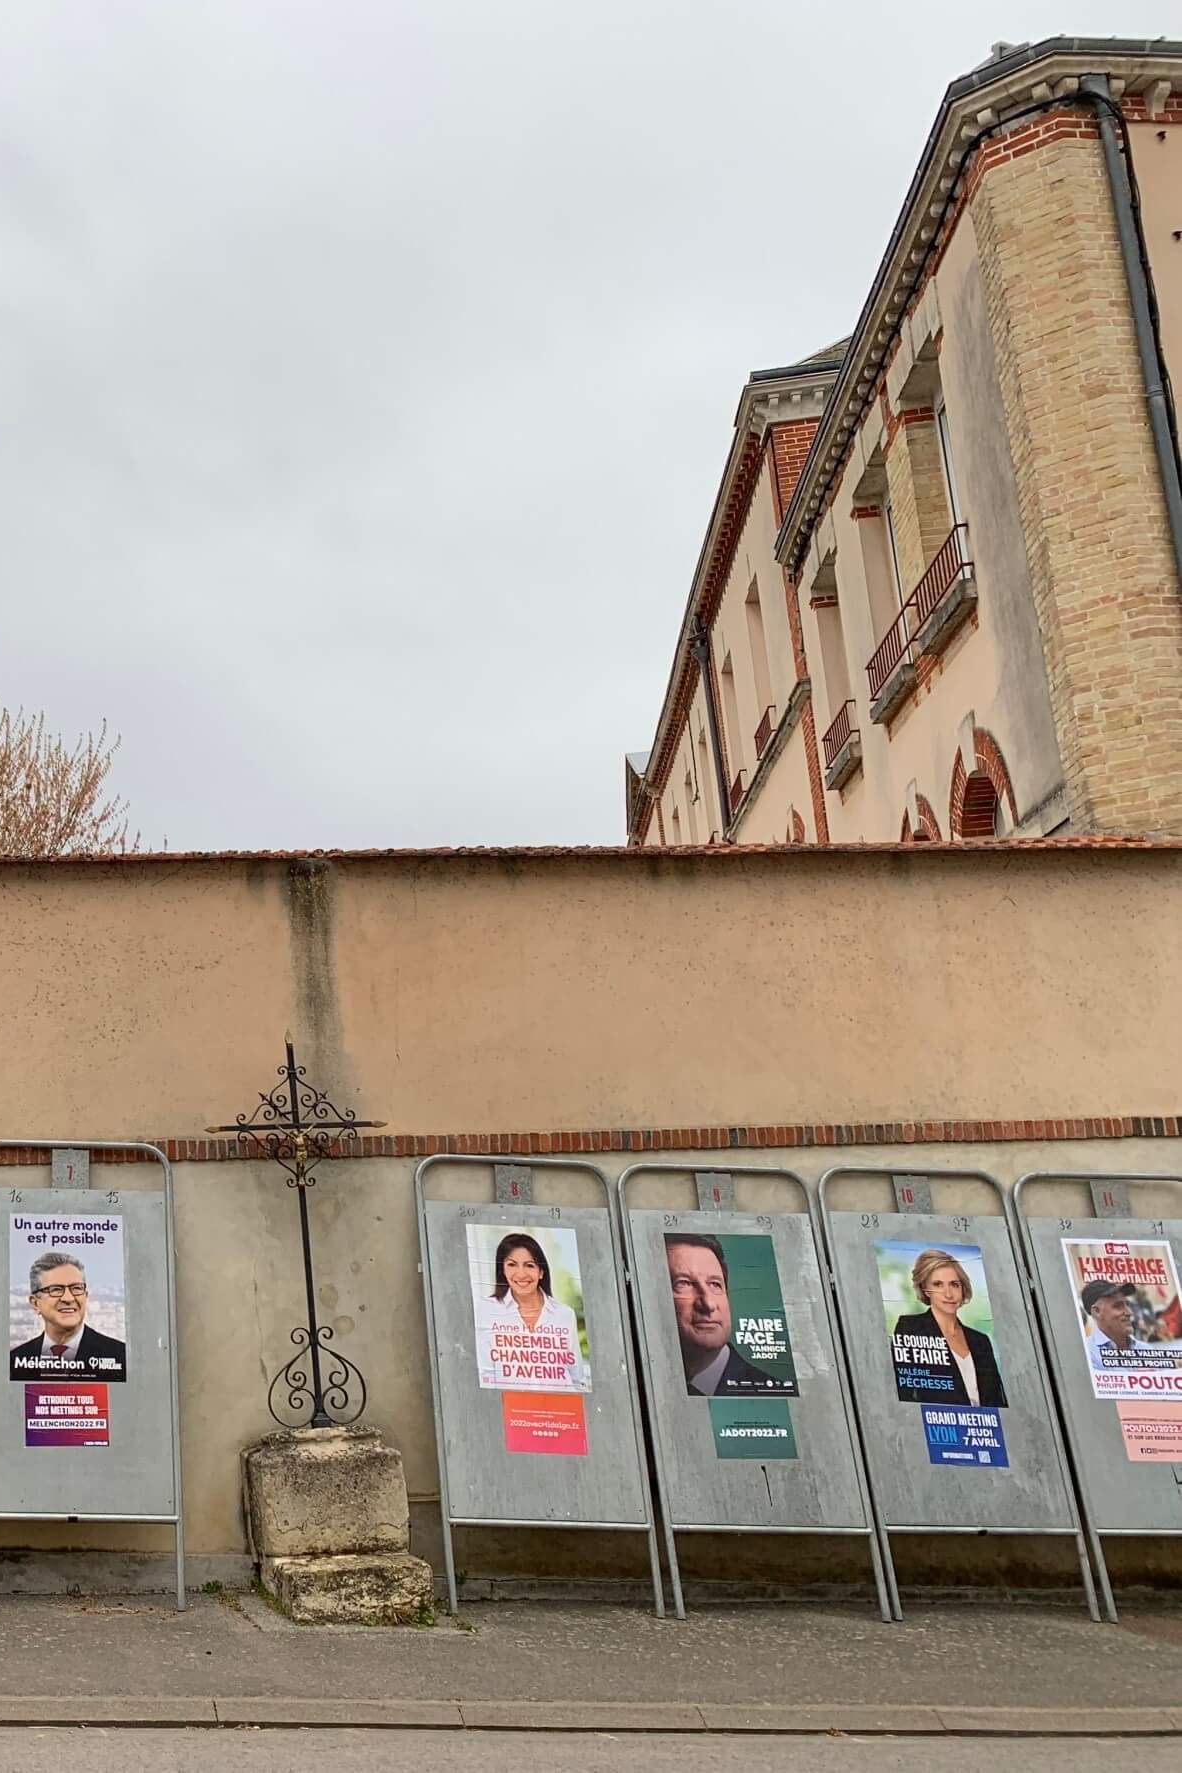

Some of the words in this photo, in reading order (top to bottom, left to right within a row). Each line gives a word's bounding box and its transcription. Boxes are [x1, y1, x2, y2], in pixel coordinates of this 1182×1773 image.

[66, 1165, 74, 1181] 7
[8, 1189, 23, 1203] 16
[106, 1191, 120, 1204] 15
[14, 1218, 32, 1230] Un
[35, 1220, 70, 1230] autre
[73, 1219, 118, 1231] monde
[861, 1214, 880, 1229] 28
[952, 1217, 971, 1232] 27
[27, 1233, 47, 1243] est
[52, 1232, 105, 1246] possible
[1078, 1257, 1166, 1274] L'URGENCE
[1083, 1273, 1167, 1285] ANTICAPITALISTE
[491, 1323, 520, 1333] Anne
[523, 1323, 569, 1336] Hidalgo
[739, 1318, 783, 1331] FAIRE
[495, 1334, 568, 1350] ENSEMBLE
[735, 1331, 775, 1344] FACE
[892, 1334, 903, 1347] LE
[903, 1334, 948, 1350] COURAGE
[14, 1356, 85, 1370] Mélenchon
[490, 1349, 576, 1365] CHANGEONS
[895, 1347, 911, 1363] DE
[913, 1349, 951, 1366] FAIRE
[502, 1364, 566, 1379] D'AVENIR
[897, 1367, 931, 1376] VALÉRIE
[898, 1376, 955, 1390] PÉCRESSE
[39, 1396, 75, 1404] RETROUVEZ
[77, 1396, 94, 1404] TOUS
[35, 1406, 49, 1415] NOS
[50, 1406, 83, 1415] MEETINGS
[84, 1406, 98, 1415] SUR
[925, 1411, 957, 1425] GRAND
[958, 1413, 998, 1427] MEETING
[719, 1428, 788, 1437] JADOT2022.FR
[927, 1426, 958, 1443] LYON
[966, 1428, 993, 1437] JEUDI
[971, 1437, 1001, 1448] AVRIL
